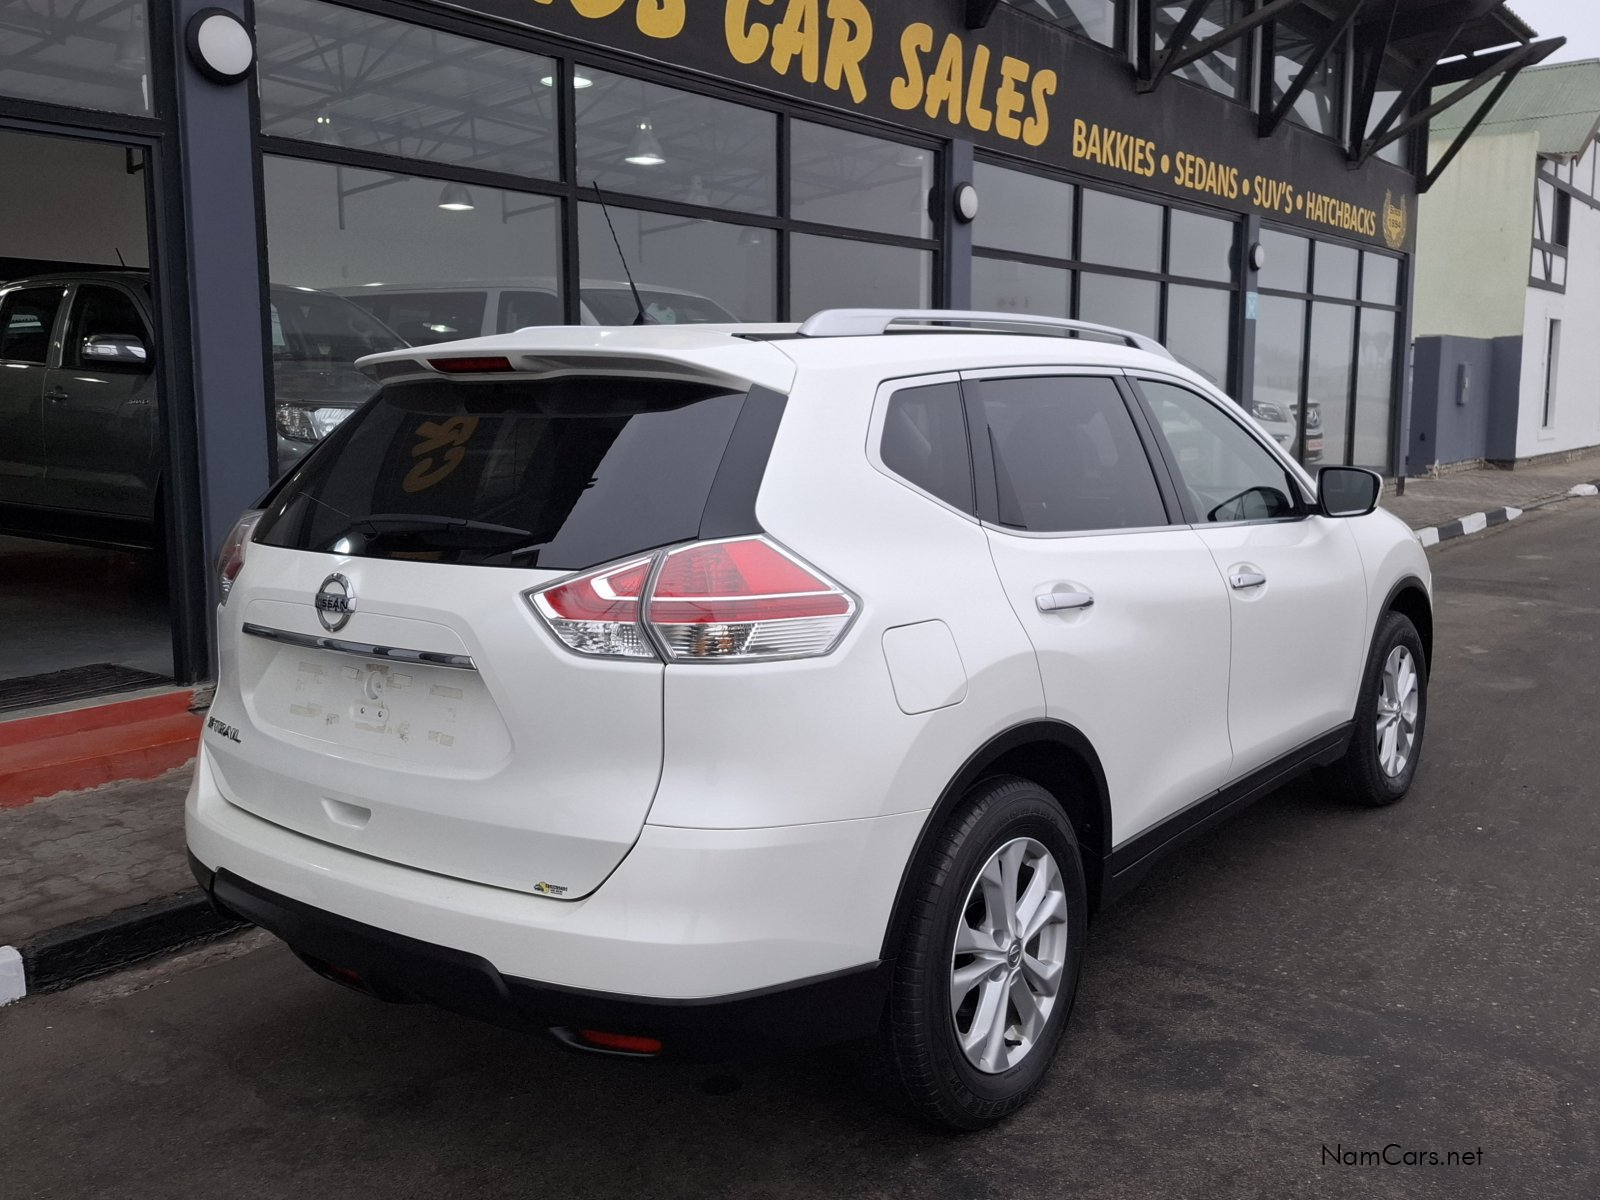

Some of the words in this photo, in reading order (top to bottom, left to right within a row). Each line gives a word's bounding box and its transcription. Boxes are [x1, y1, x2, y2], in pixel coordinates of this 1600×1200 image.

[724, 0, 874, 104] CAR
[889, 22, 1058, 147] SALES
[1073, 118, 1156, 177] BAKKIES
[1174, 151, 1239, 200] SEDANS
[1253, 175, 1294, 215] SUV'S
[1306, 190, 1377, 237] HATCHBACKS
